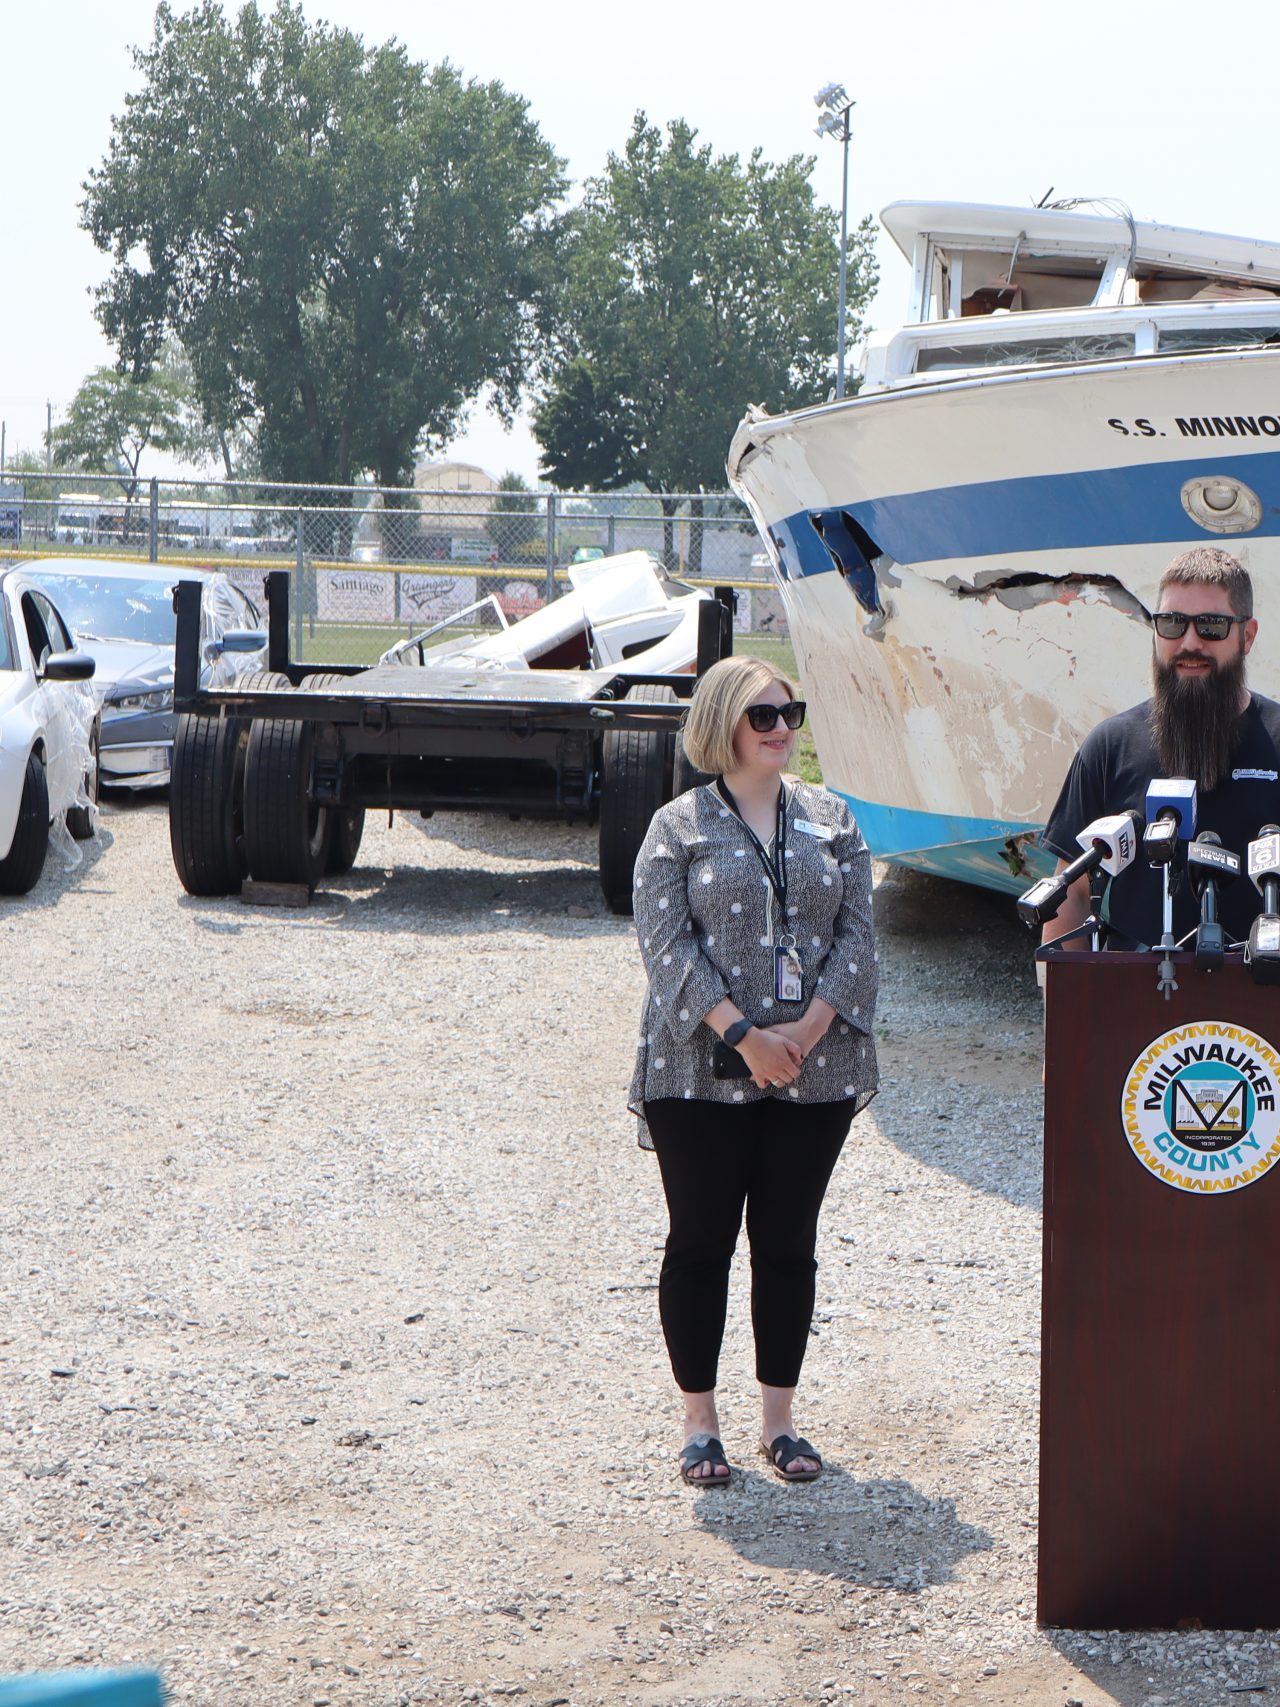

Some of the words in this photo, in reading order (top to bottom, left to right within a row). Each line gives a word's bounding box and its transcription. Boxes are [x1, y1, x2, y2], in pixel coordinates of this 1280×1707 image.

[1107, 418, 1167, 437] S.S.
[330, 578, 384, 596] Santiago
[1200, 852, 1226, 864] NEWS
[1255, 849, 1273, 865] 6
[1144, 1044, 1275, 1112] MILWAUKEE
[1153, 1131, 1261, 1172] COUNTY
